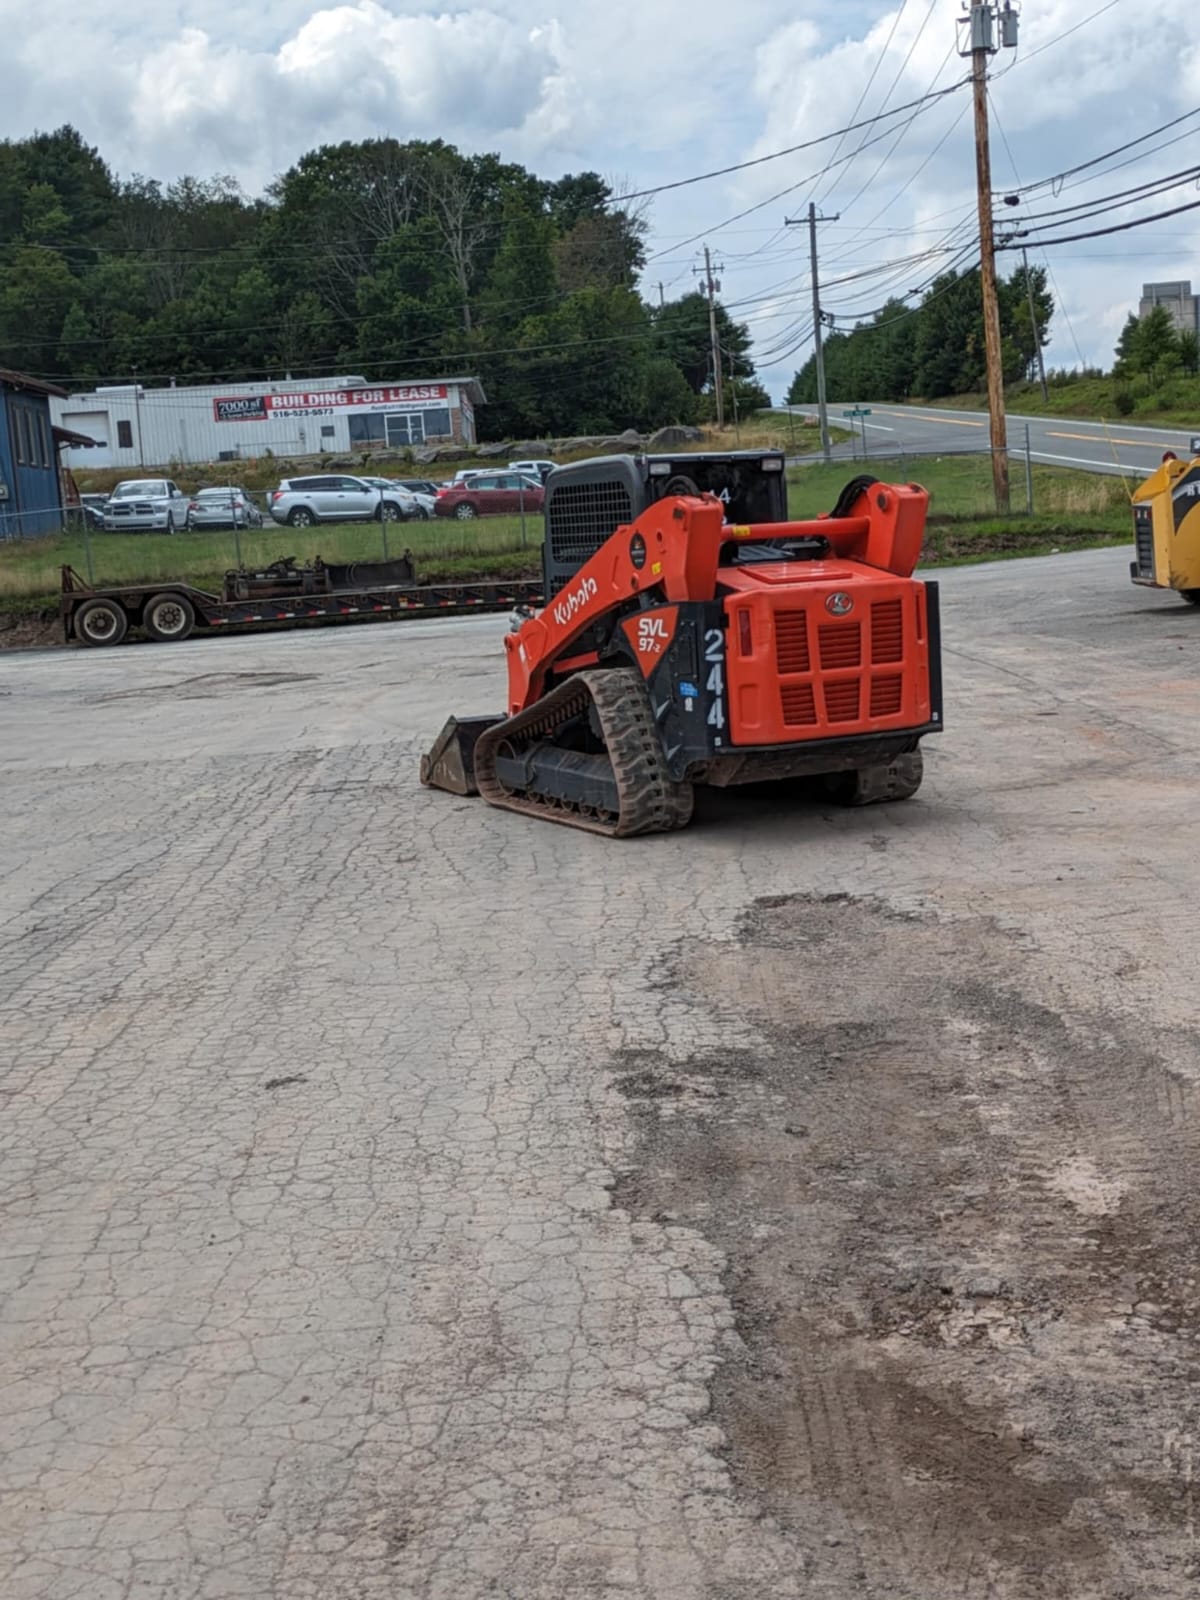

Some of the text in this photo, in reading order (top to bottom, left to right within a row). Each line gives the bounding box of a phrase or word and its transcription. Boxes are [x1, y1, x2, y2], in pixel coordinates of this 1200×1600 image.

[271, 385, 440, 408] BUILDING FOR LEASE
[553, 577, 598, 625] Kubota
[638, 618, 668, 637] SVL
[638, 637, 661, 653] 97-2
